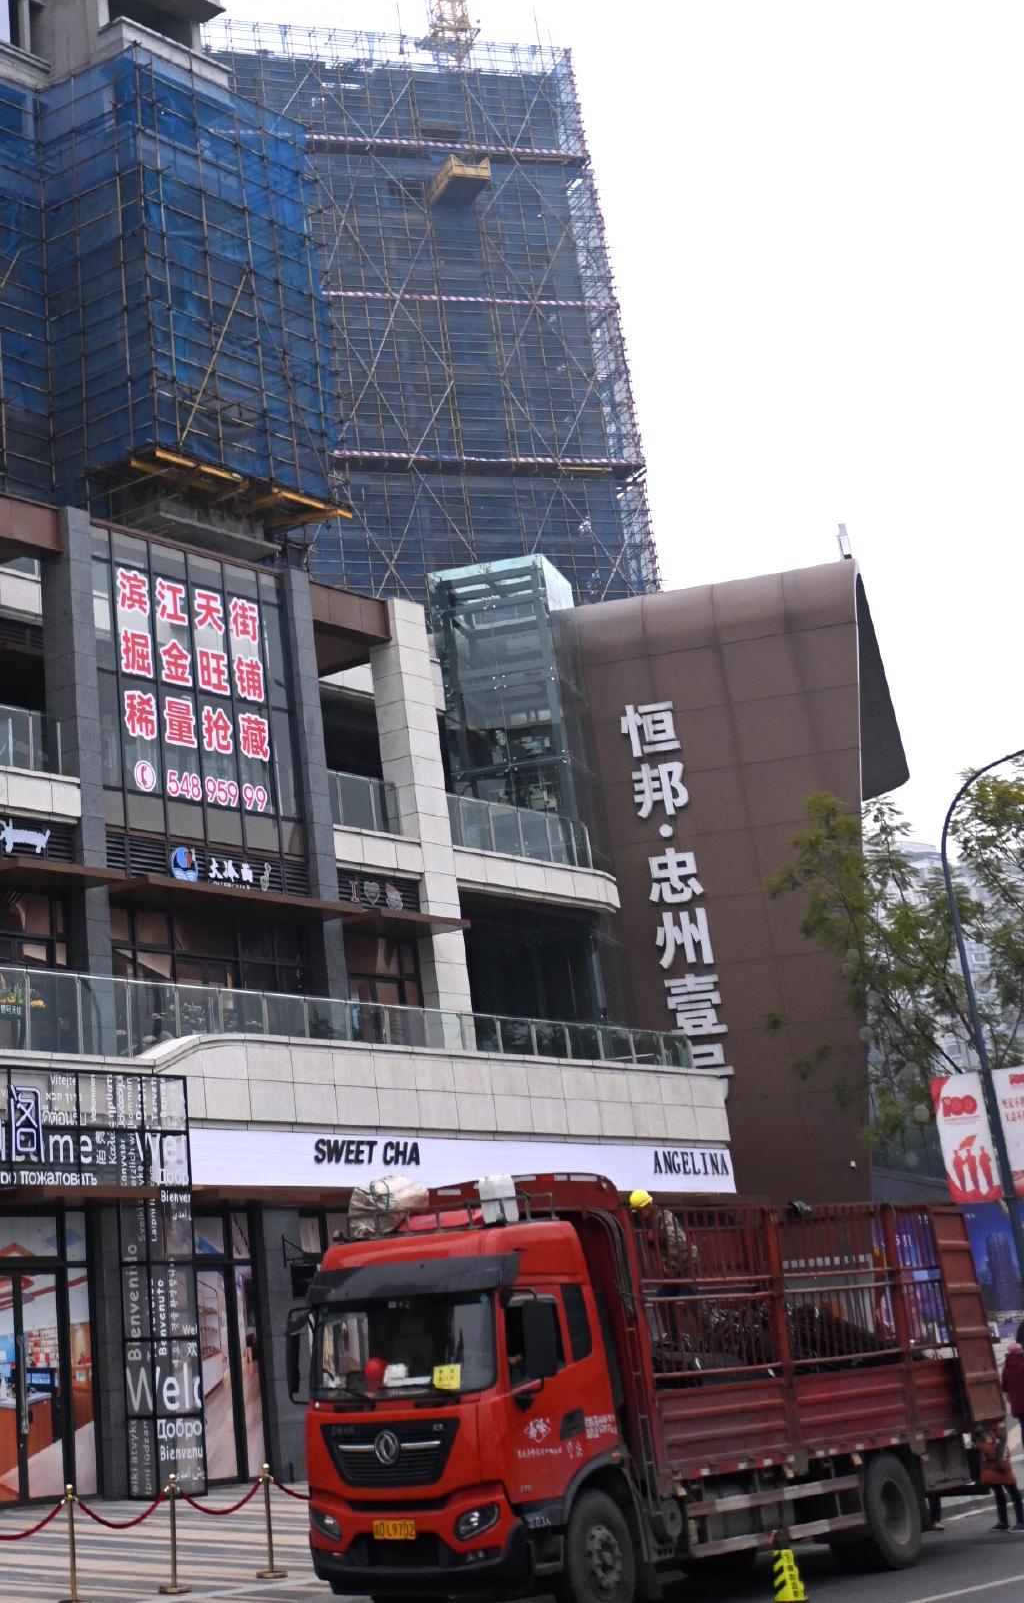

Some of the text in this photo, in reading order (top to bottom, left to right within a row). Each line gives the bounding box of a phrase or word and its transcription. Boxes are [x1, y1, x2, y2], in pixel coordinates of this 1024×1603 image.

[117, 568, 260, 644] 滨江天街
[121, 629, 265, 703] 掘金旺铺
[124, 690, 271, 762] 稀量抢藏
[166, 769, 268, 812] 548 959 99
[314, 1138, 421, 1167] SWEET CHA
[653, 1150, 730, 1177] ANGELINA
